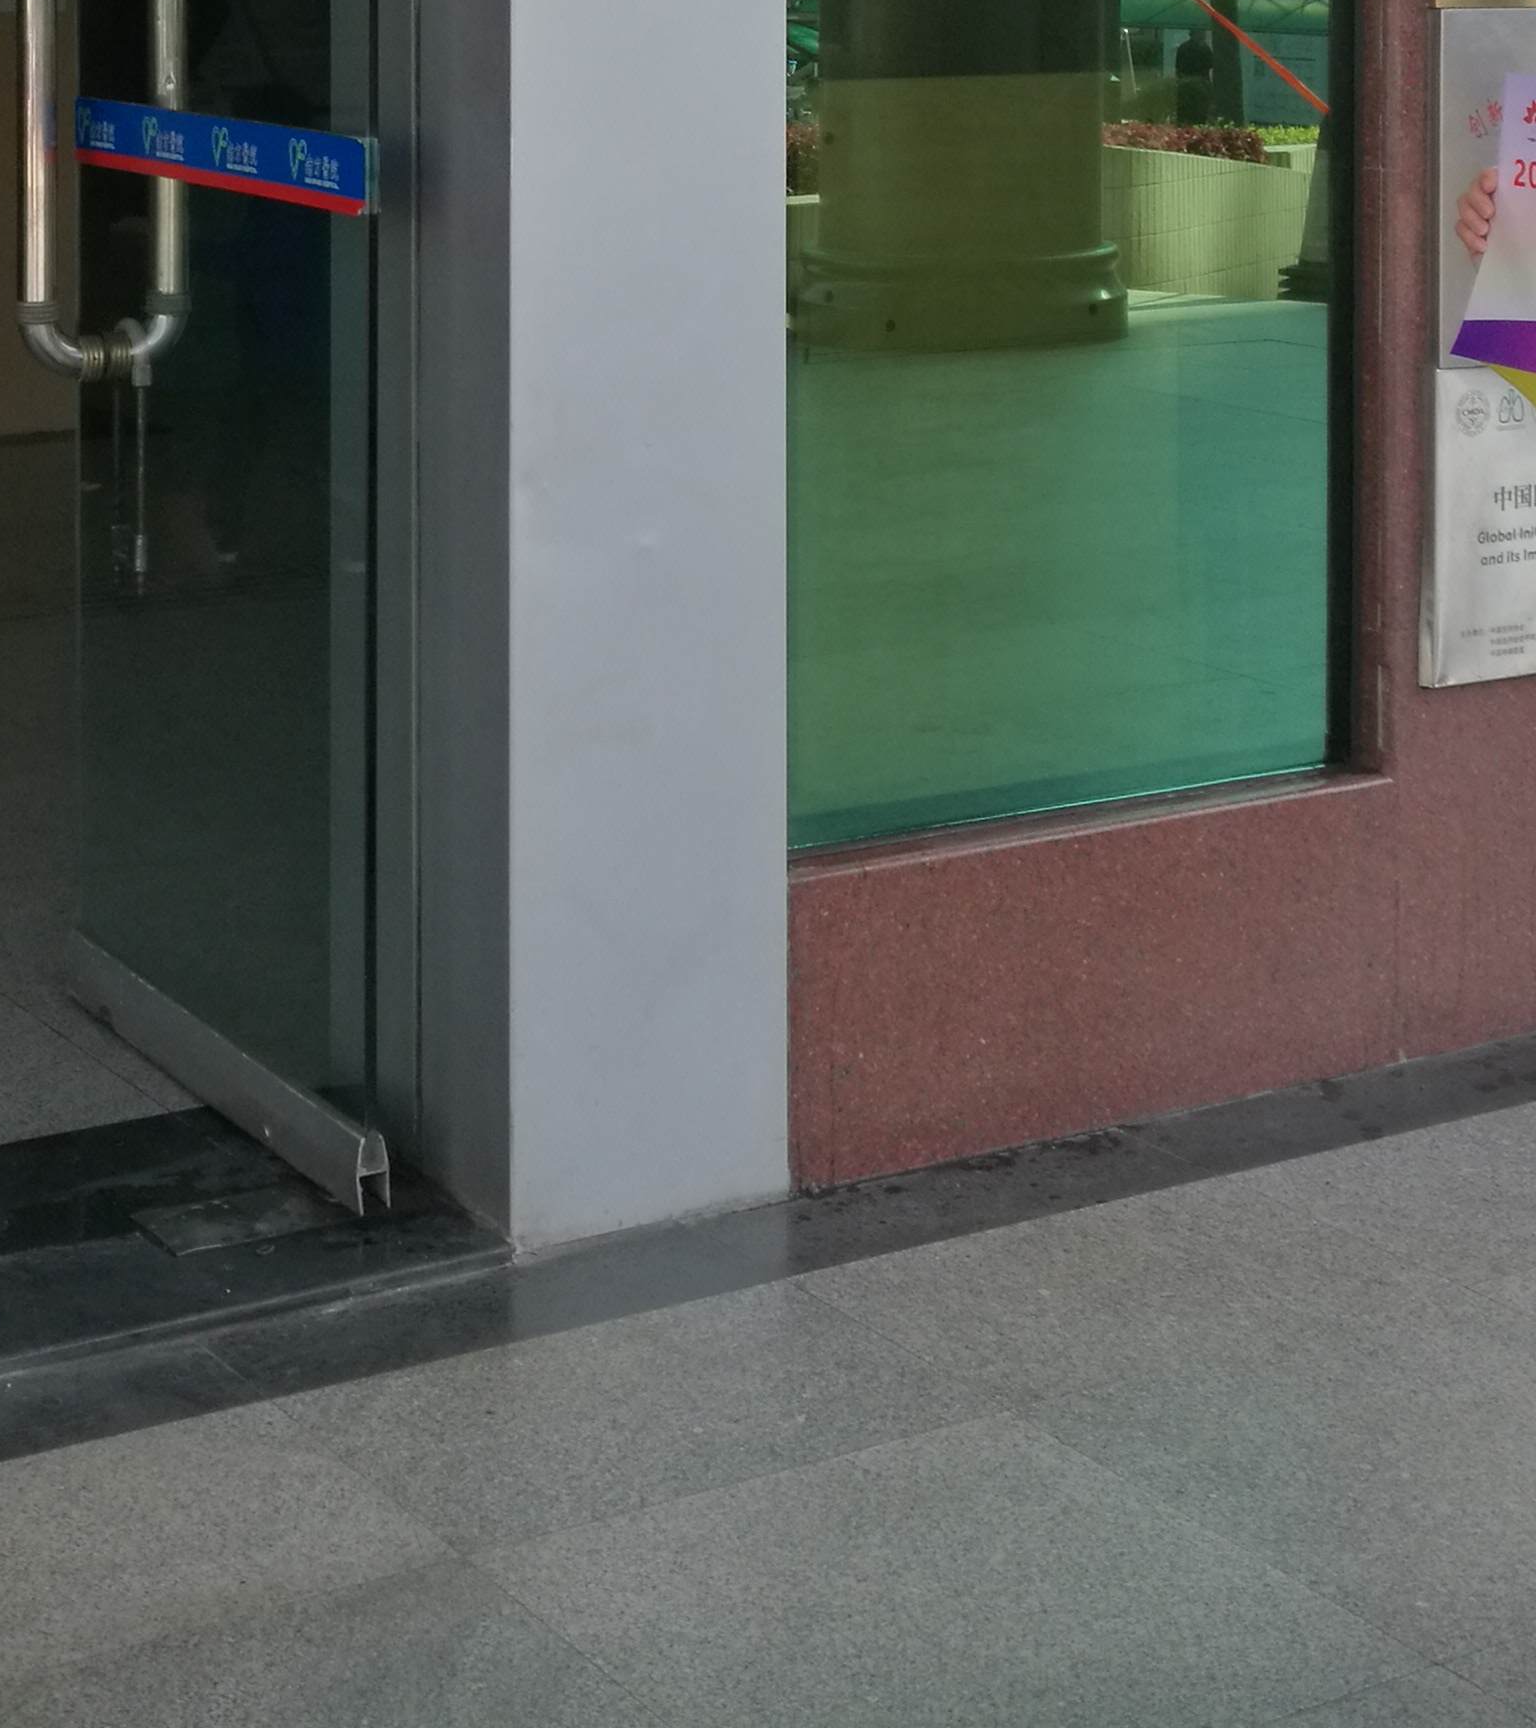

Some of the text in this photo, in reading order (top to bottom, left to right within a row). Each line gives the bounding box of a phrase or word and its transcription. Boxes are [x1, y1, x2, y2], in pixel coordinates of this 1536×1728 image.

[1477, 529, 1517, 545] Global
[1480, 551, 1505, 567] and
[1506, 548, 1521, 563] its
